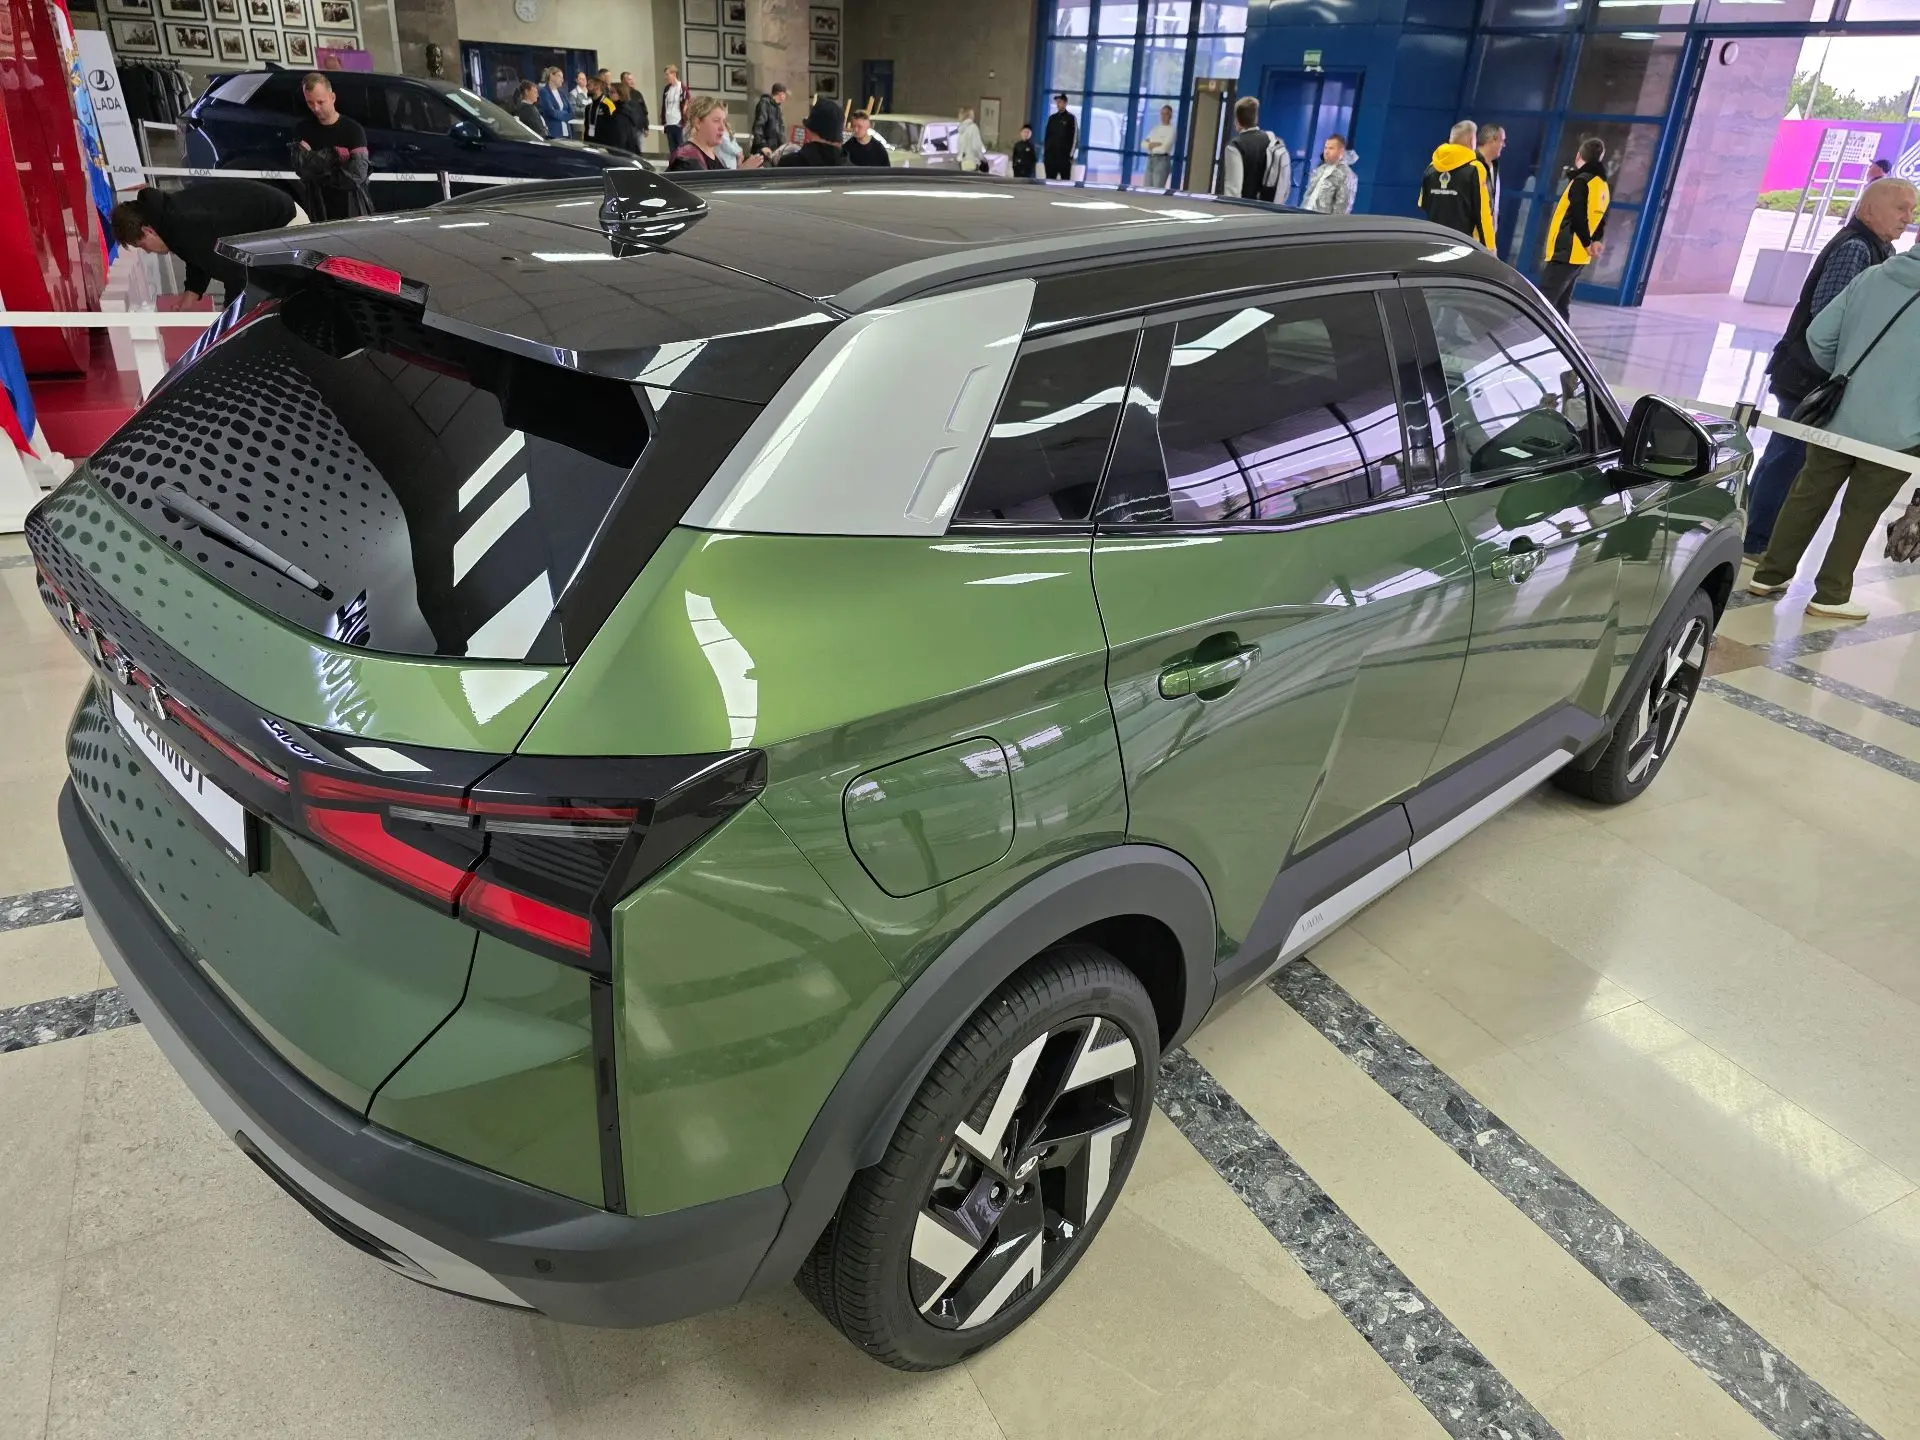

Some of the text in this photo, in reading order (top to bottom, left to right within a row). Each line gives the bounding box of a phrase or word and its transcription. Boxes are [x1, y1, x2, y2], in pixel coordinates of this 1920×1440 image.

[94, 97, 121, 110] LADA
[113, 166, 137, 174] LADA
[188, 168, 212, 176] LADA
